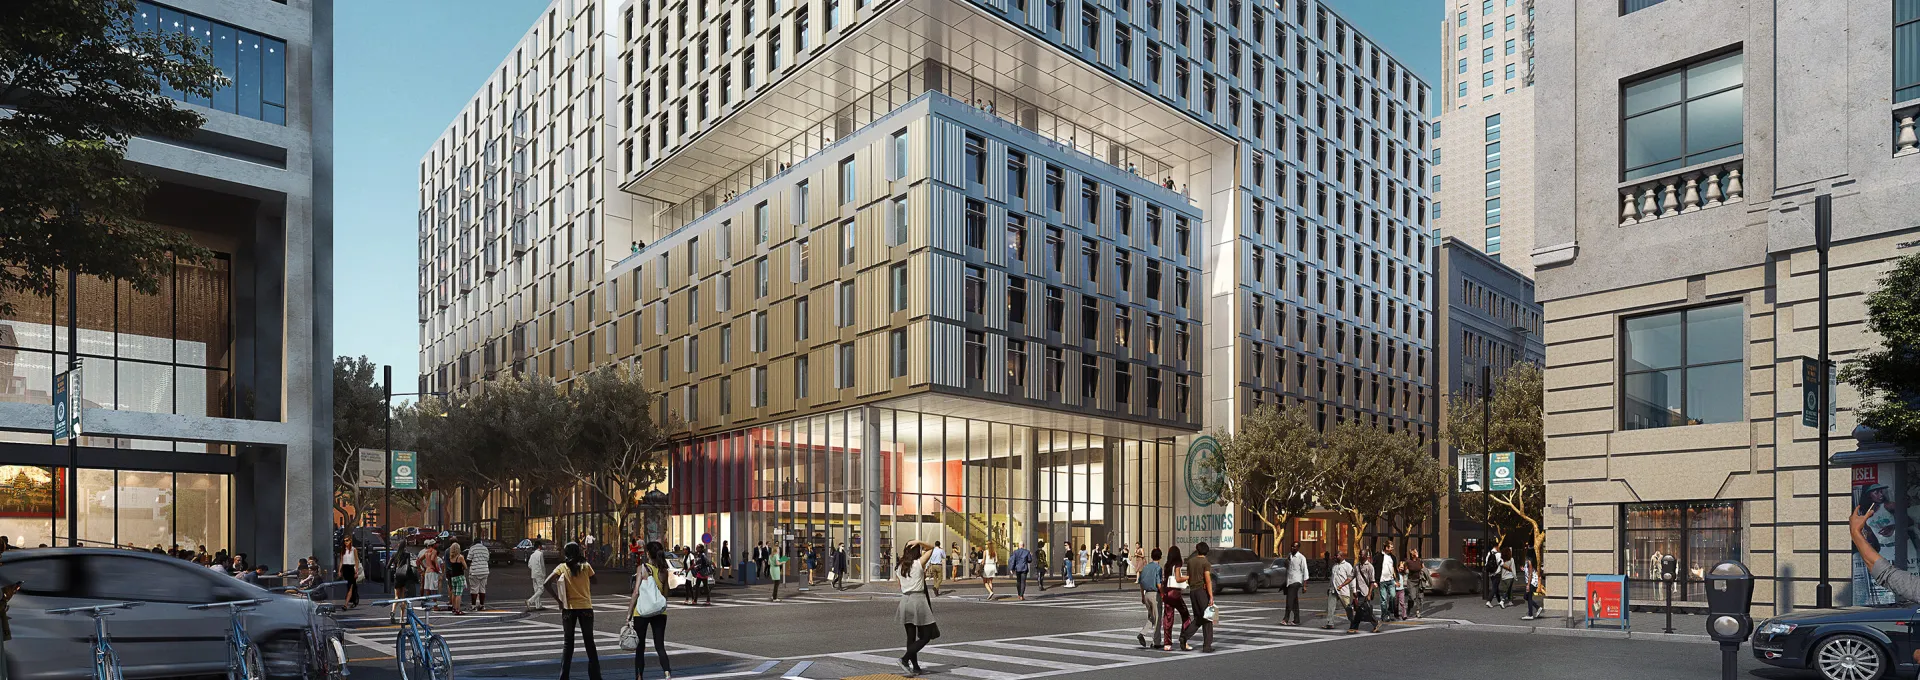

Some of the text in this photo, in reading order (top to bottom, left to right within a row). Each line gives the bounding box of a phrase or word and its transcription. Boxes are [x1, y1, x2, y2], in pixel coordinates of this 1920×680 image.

[1852, 467, 1876, 481] IESEL
[1176, 513, 1233, 531] UC HASTINGS
[1176, 536, 1199, 544] COLLEGE
[1220, 535, 1233, 543] LAW
